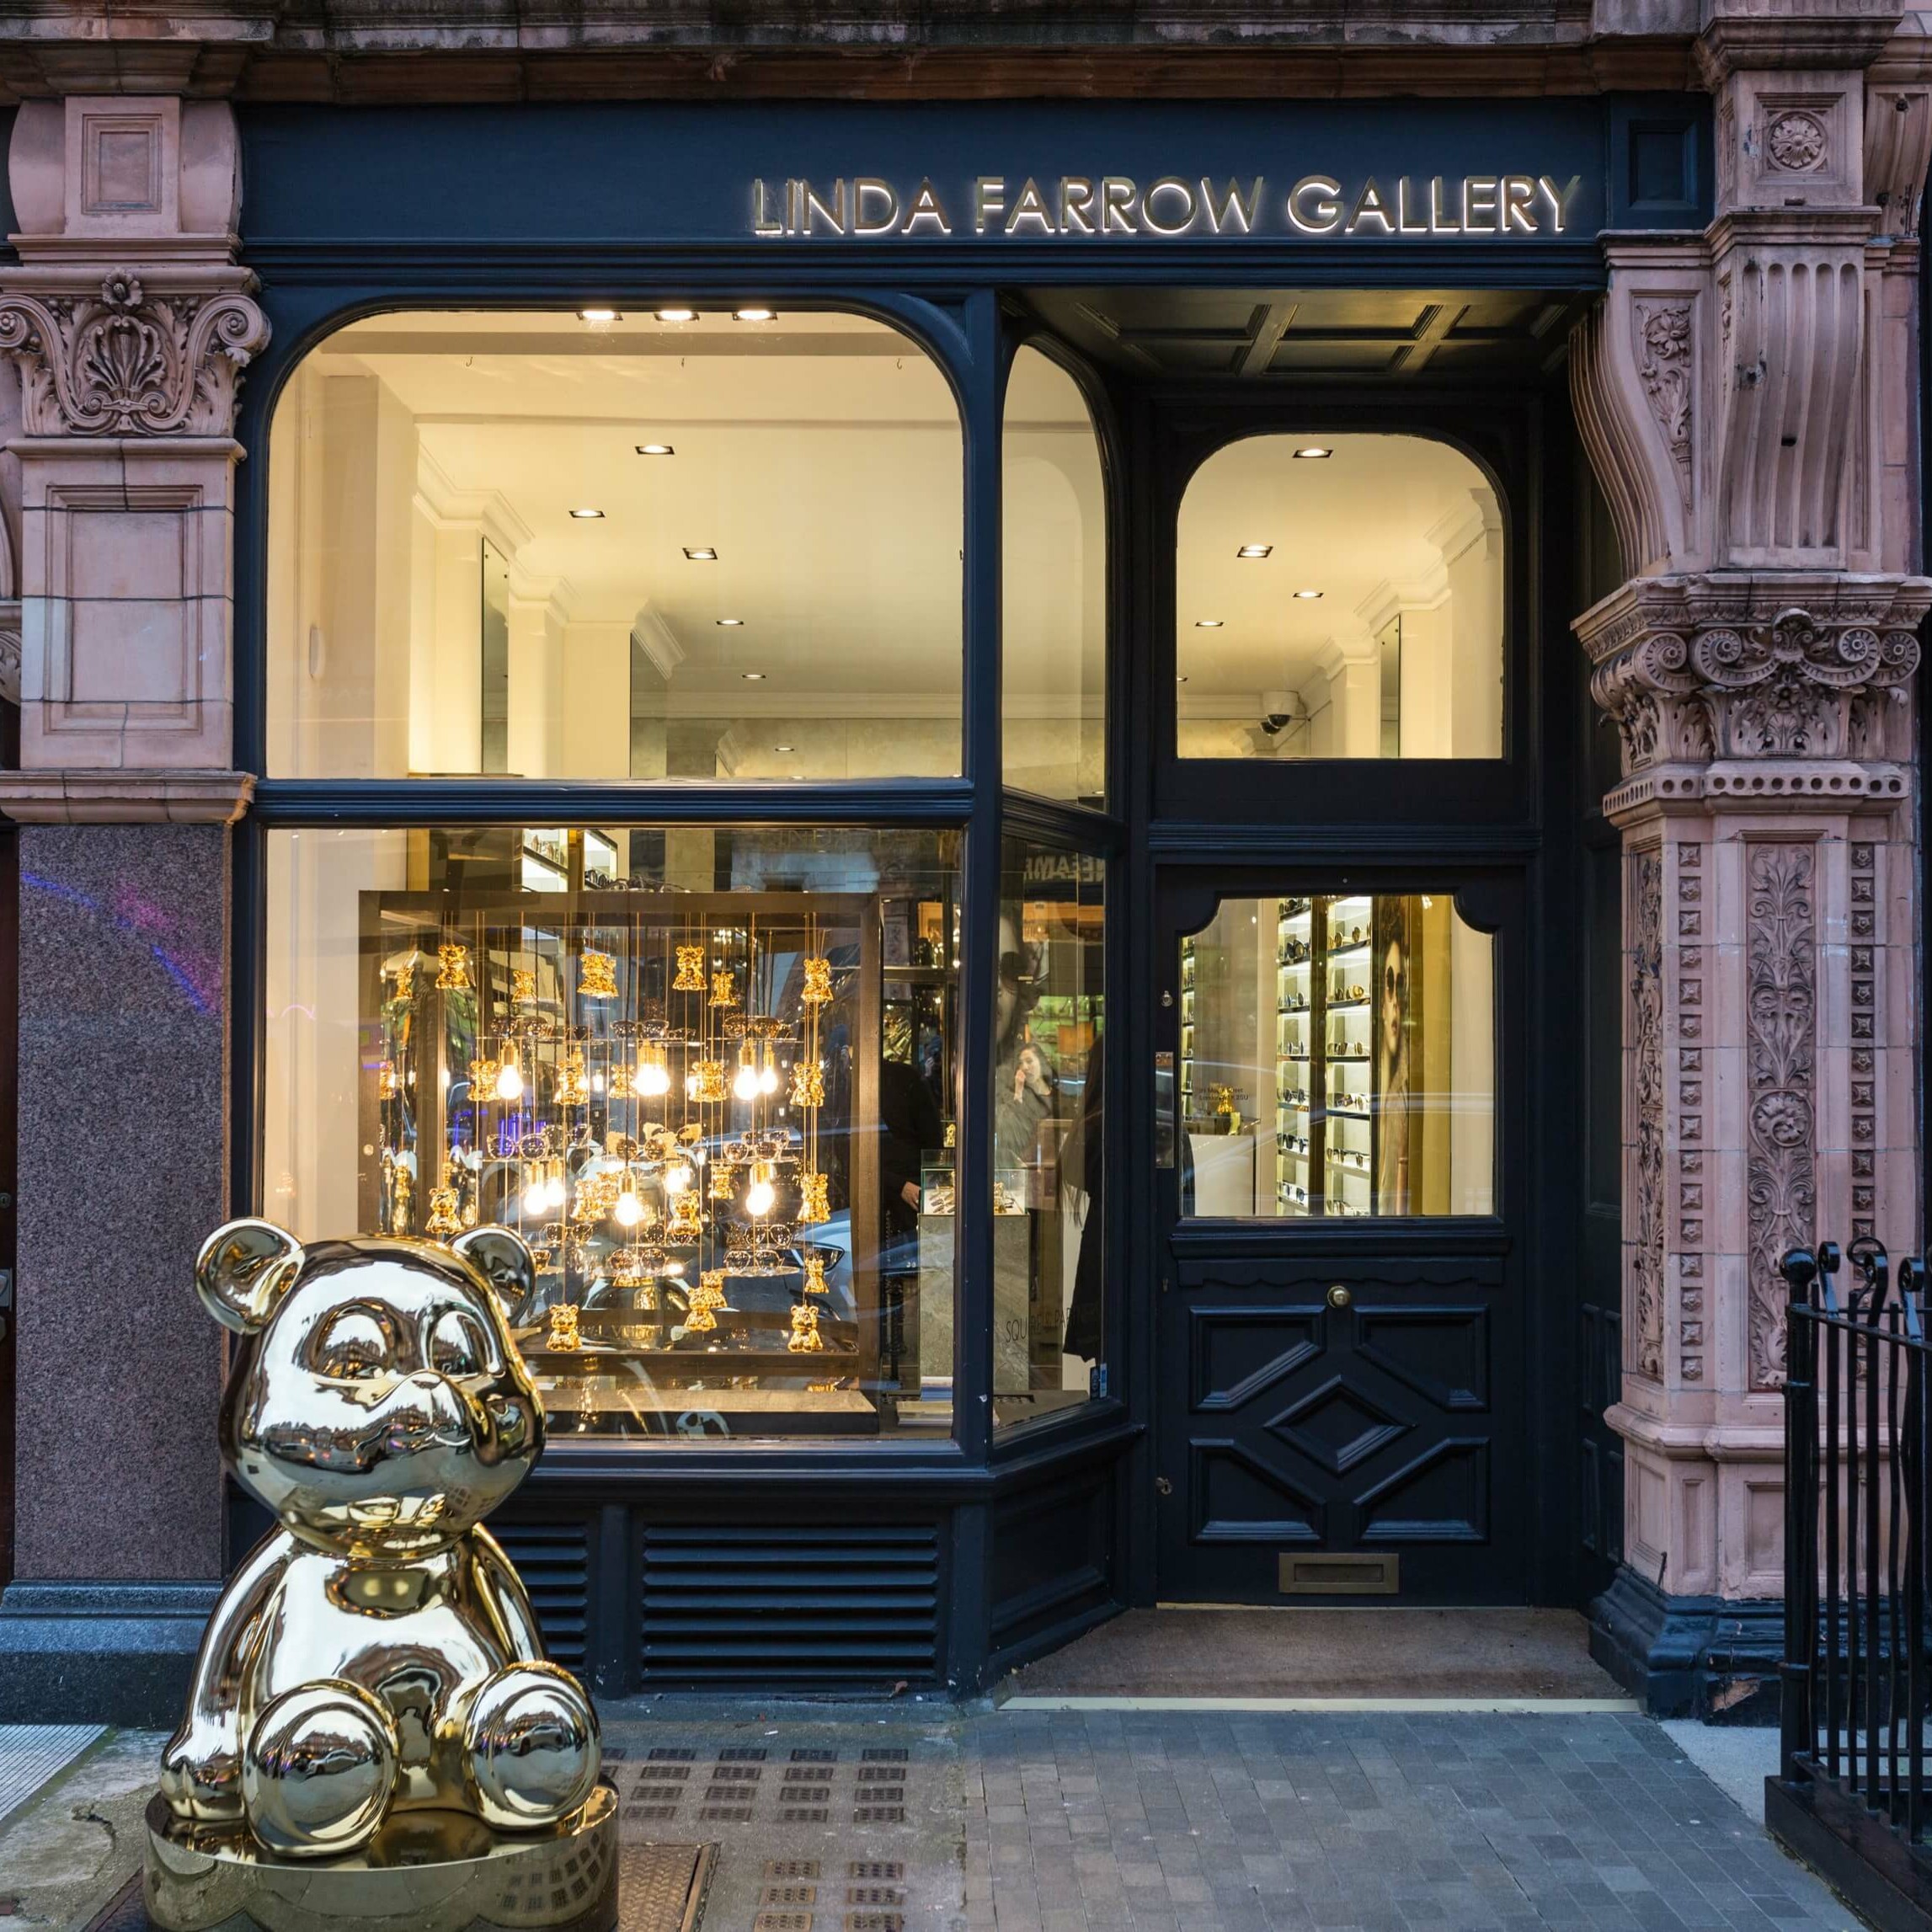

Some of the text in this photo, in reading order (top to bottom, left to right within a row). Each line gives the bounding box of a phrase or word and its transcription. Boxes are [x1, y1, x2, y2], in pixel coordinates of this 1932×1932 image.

[755, 174, 1582, 235] LINDA FARROW GALLERY
